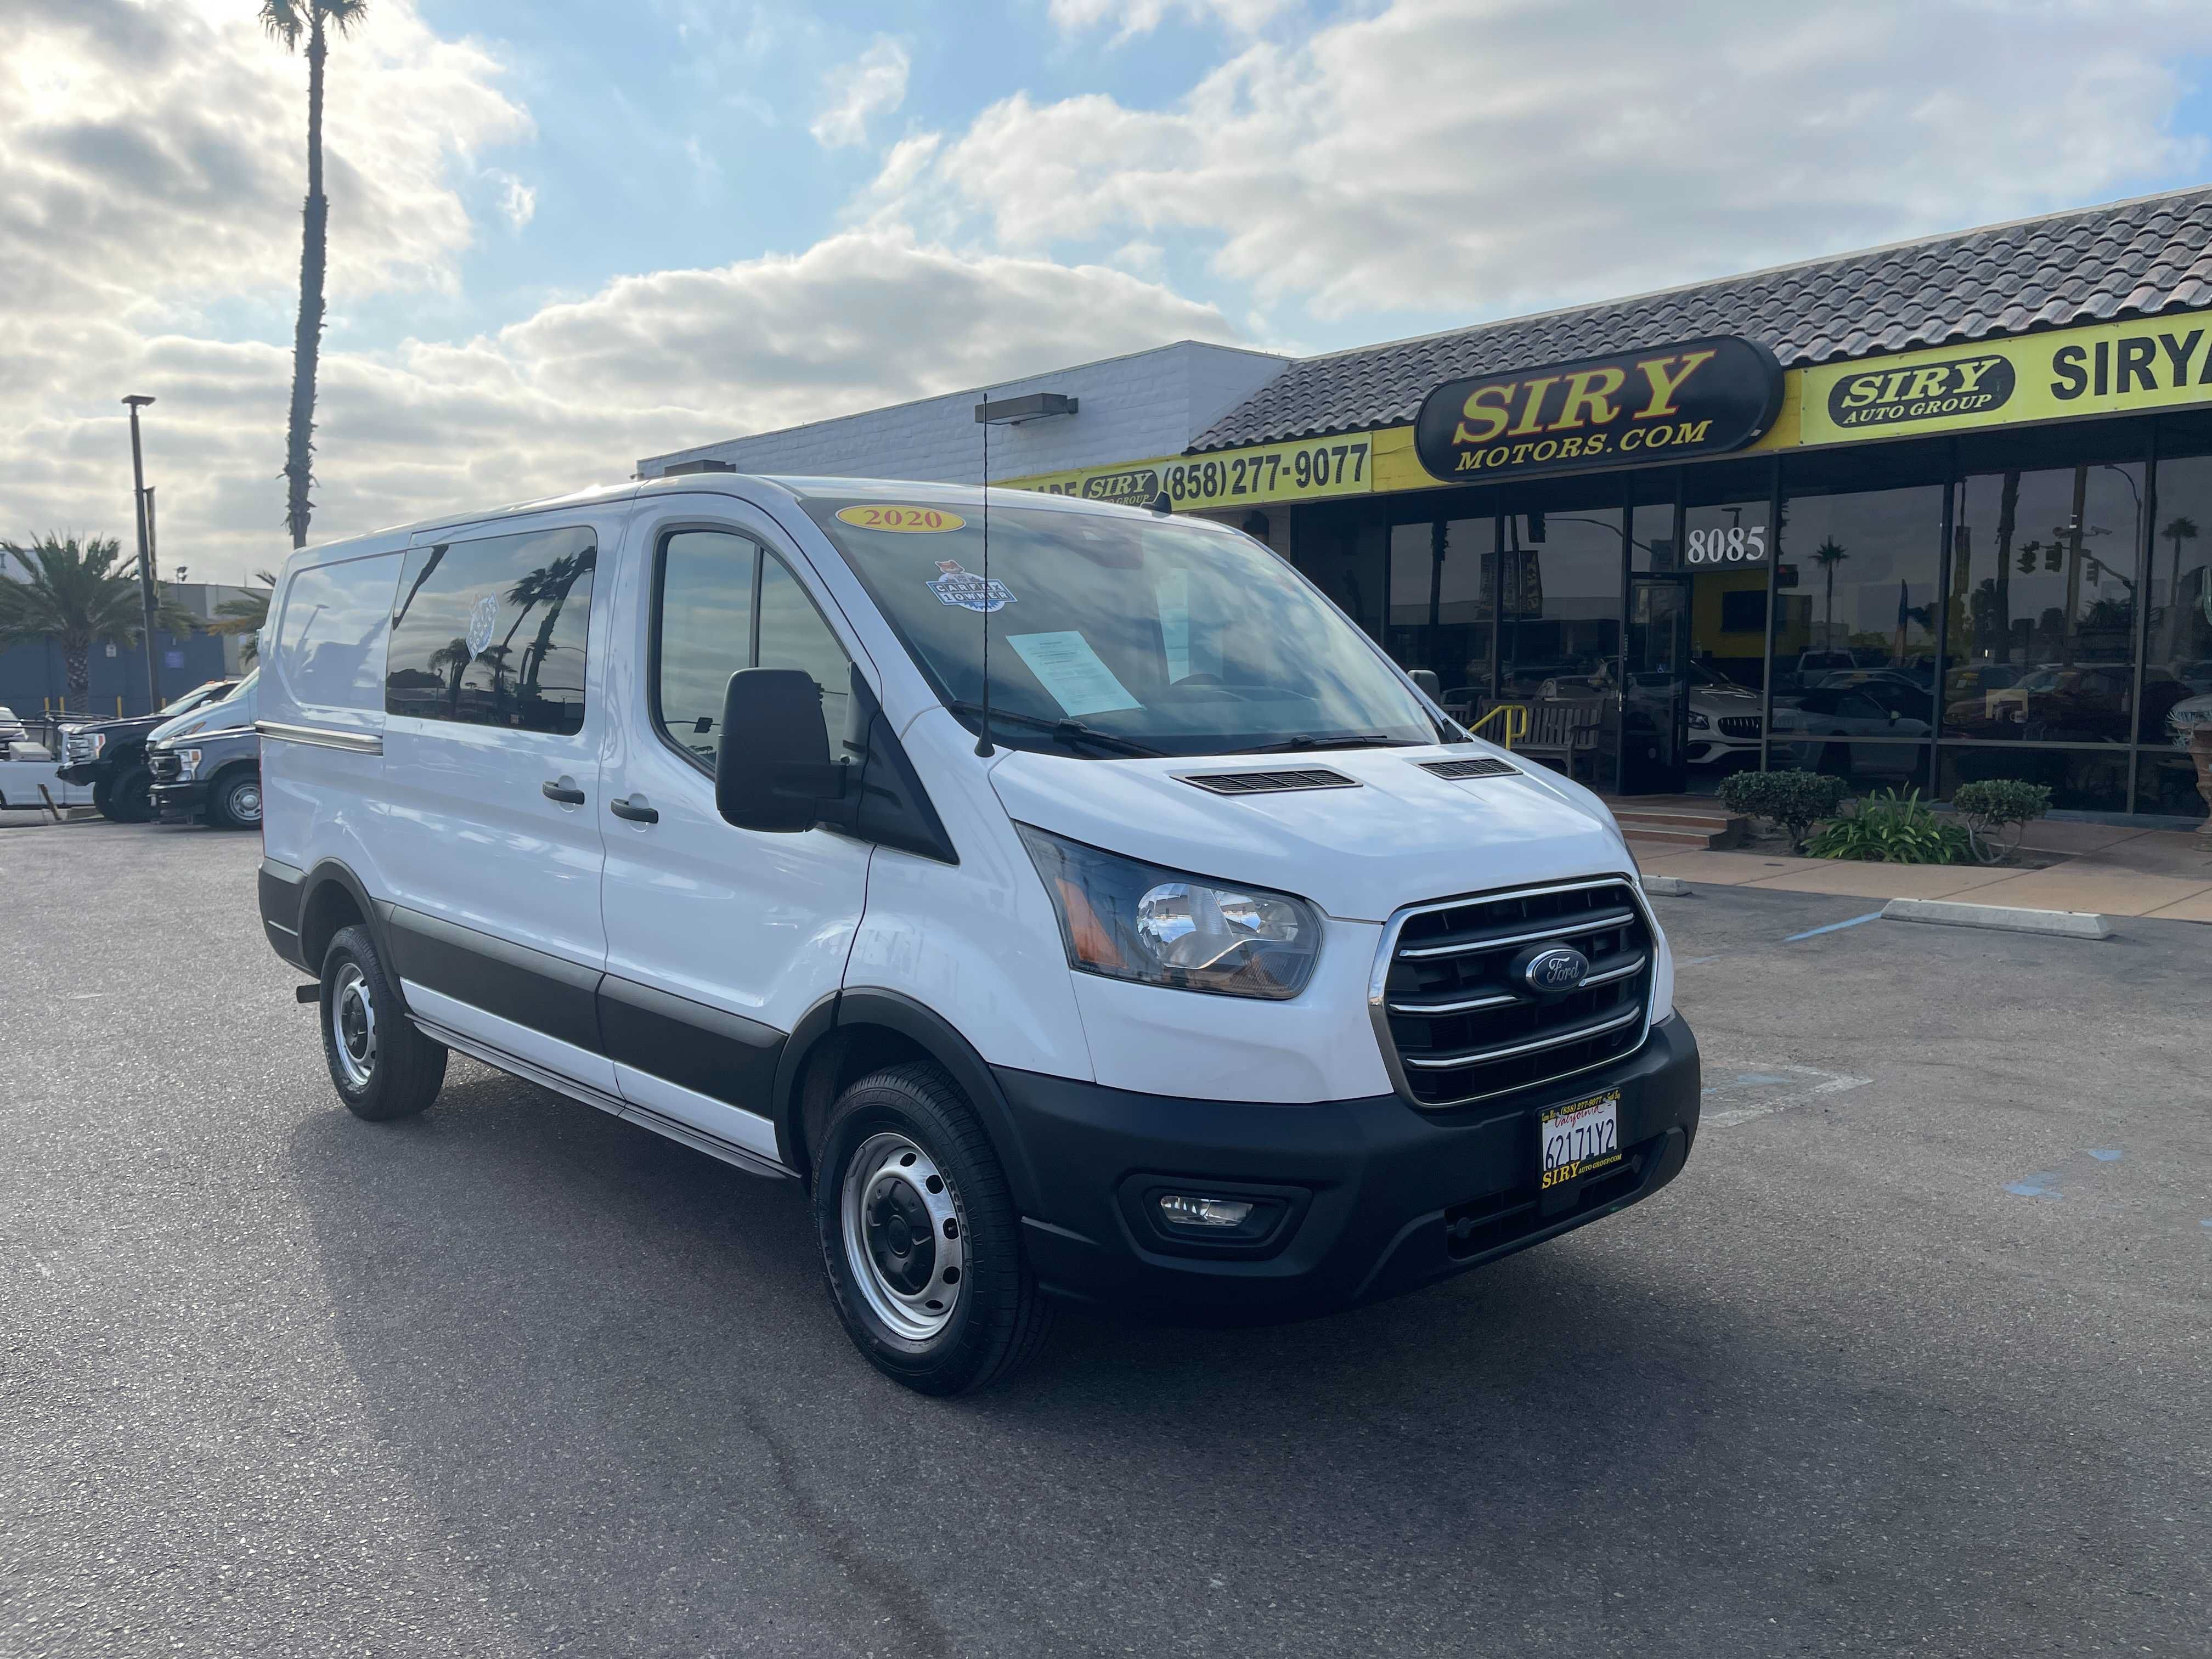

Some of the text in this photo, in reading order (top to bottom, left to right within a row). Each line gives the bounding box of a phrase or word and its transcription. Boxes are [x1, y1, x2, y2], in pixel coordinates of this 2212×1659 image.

[1451, 348, 1718, 447] SIRY
[1841, 358, 2001, 409] SIRY
[1843, 393, 1992, 424] AUTO GROUP
[1455, 420, 1713, 471] MOTORS.COM
[1088, 472, 1153, 499] SIRY
[1116, 494, 1150, 505] GROUP
[864, 509, 943, 528] 2020
[1687, 526, 1765, 563] 8085
[954, 591, 1008, 601] OWNER
[1547, 956, 1579, 983] Ford
[1555, 1105, 1604, 1128] California
[1545, 1119, 1615, 1170] 62171Y2
[1542, 1161, 1581, 1189] SIRY
